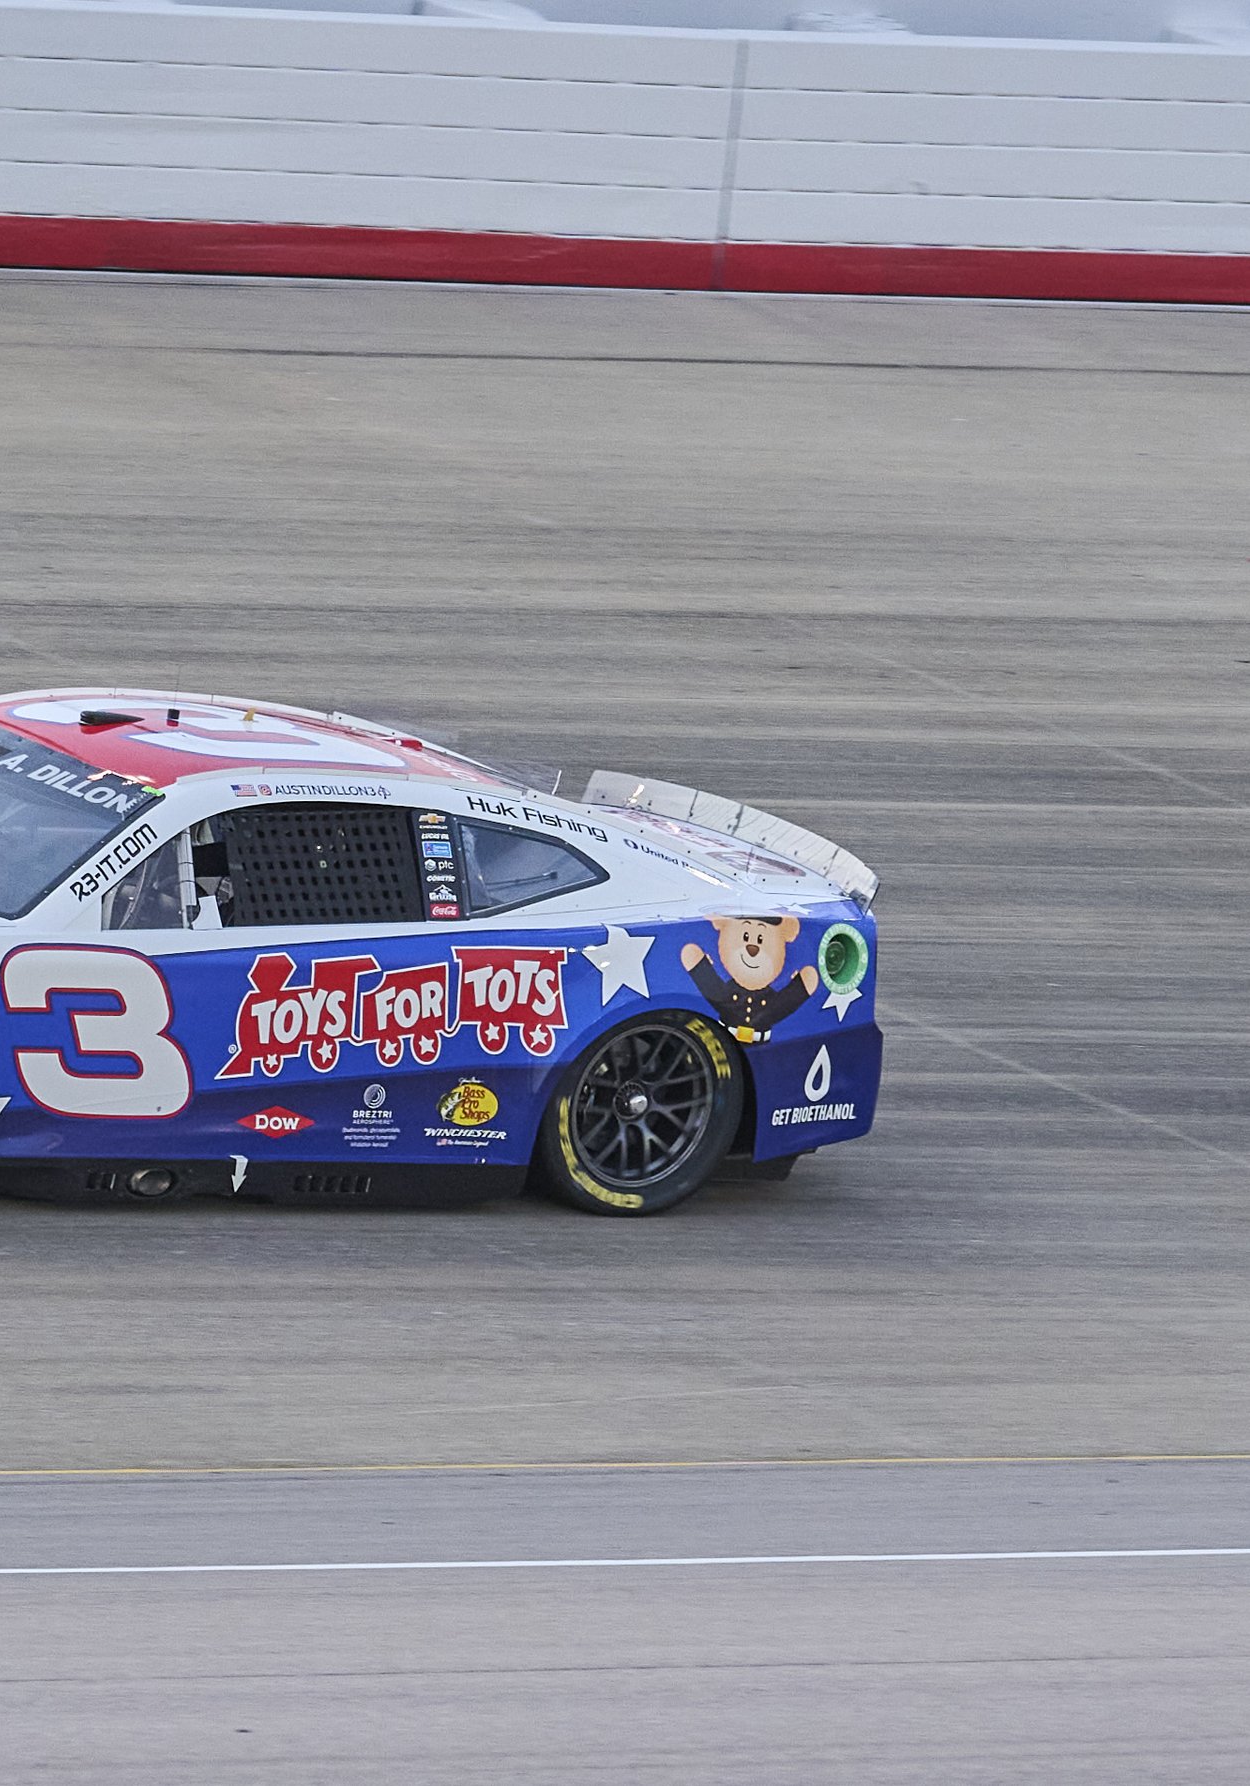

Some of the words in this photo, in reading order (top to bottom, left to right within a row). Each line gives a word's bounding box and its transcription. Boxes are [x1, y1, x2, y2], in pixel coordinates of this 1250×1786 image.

[27, 764, 133, 814] DILLON
[467, 795, 518, 819] Huk
[522, 806, 608, 842] Fishing
[641, 844, 679, 866] United
[251, 987, 347, 1044] TOYS
[375, 980, 444, 1031] FOR
[464, 959, 557, 1017] TOTS
[2, 943, 192, 1118] 3
[462, 1086, 485, 1099] Bass
[352, 1110, 393, 1119] BREZTRI
[772, 1108, 791, 1126] GET
[791, 1104, 857, 1123] BIOETHANOL
[424, 1128, 507, 1140] WINCHESTER
